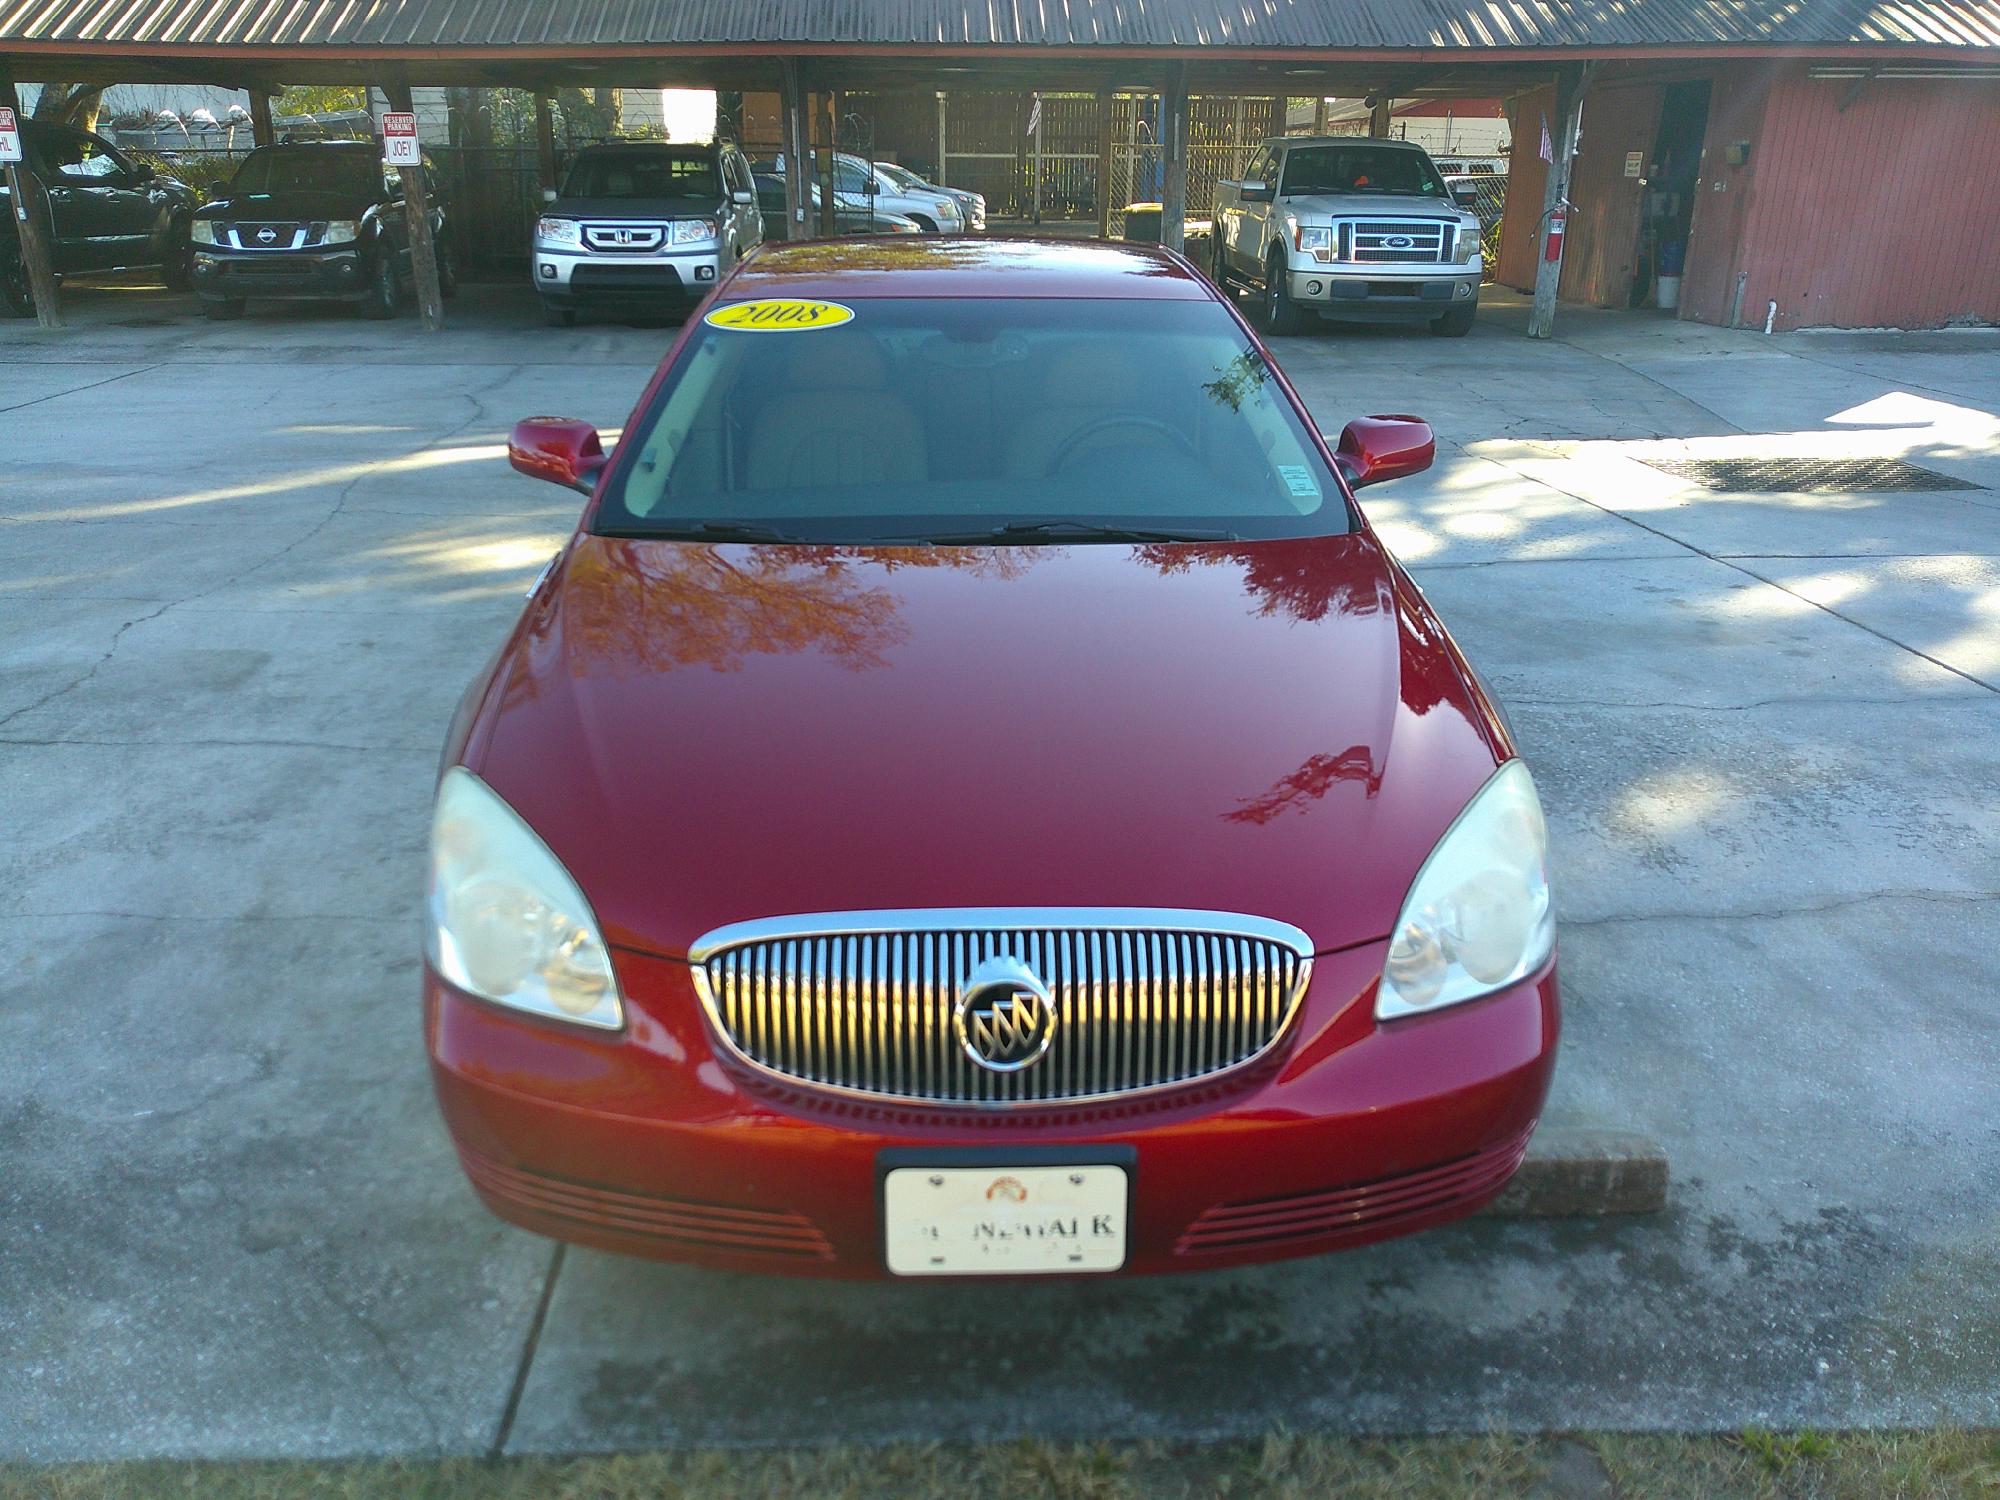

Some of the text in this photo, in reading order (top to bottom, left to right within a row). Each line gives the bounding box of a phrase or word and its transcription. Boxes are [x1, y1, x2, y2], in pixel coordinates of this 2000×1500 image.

[384, 115, 413, 123] RESERVED
[387, 123, 412, 131] PARKING
[393, 140, 412, 156] JOEY
[724, 304, 828, 323] 2008
